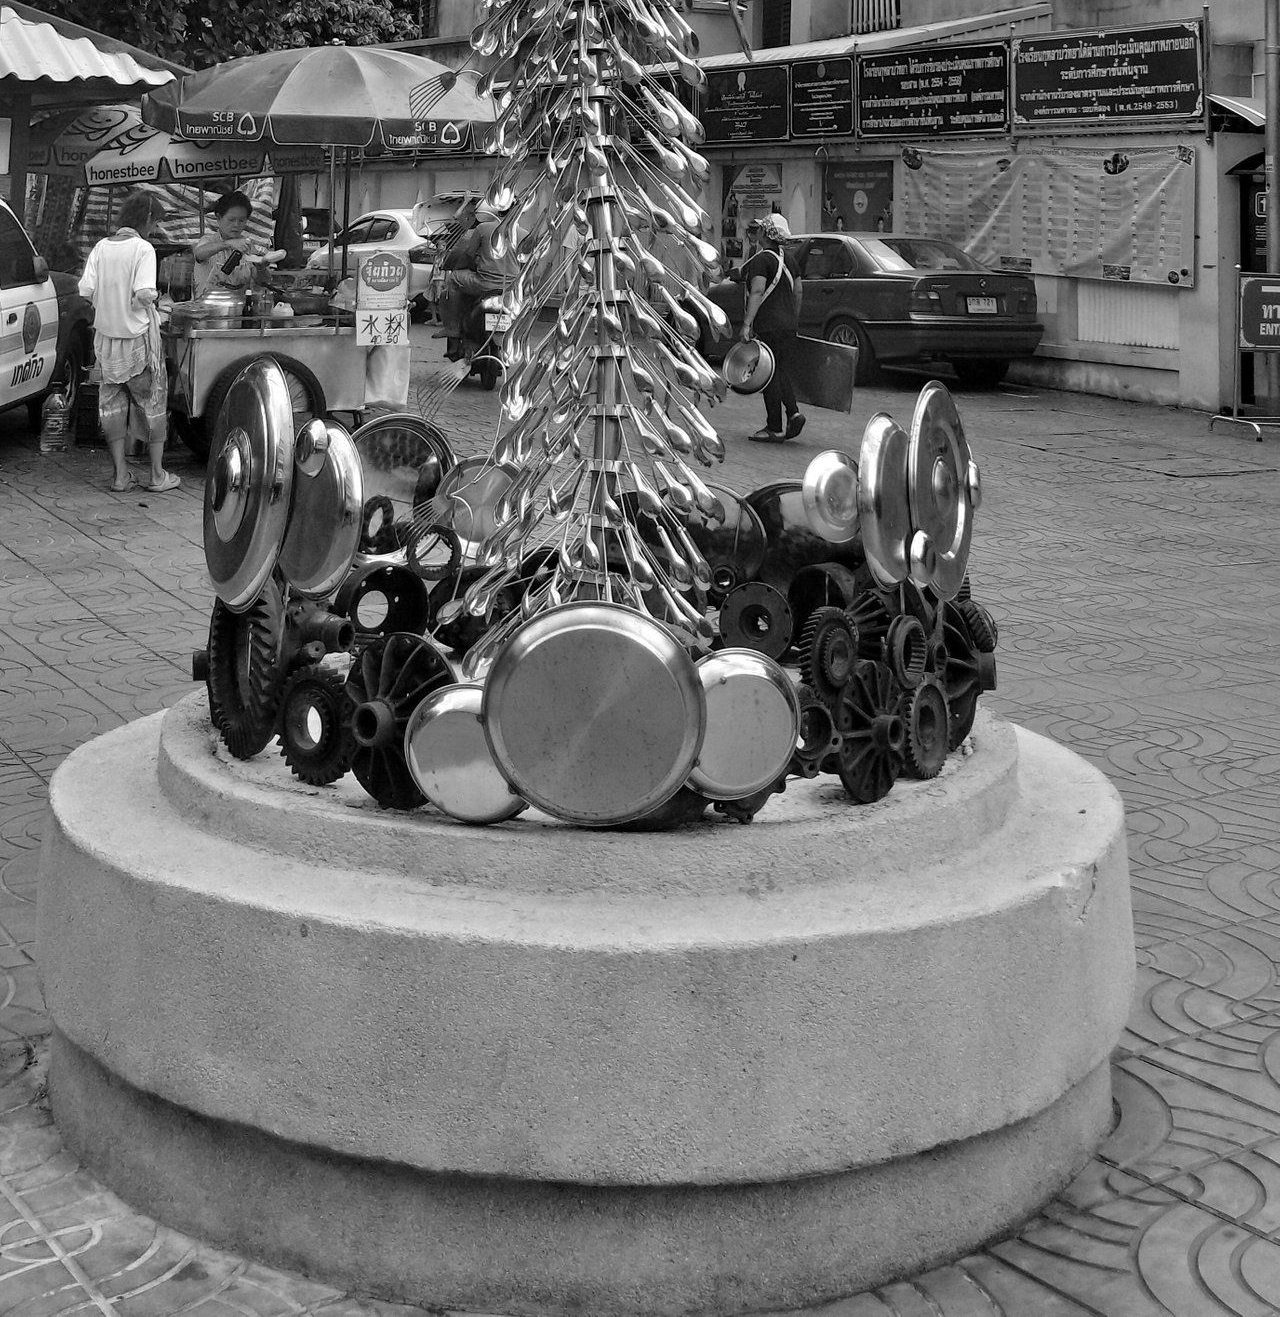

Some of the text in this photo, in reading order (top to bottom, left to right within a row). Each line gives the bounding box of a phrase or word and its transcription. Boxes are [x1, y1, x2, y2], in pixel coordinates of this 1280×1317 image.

[212, 111, 234, 122] SCB
[186, 124, 234, 135] ไทยพาณิชย์
[90, 163, 155, 181] honestbee
[175, 156, 258, 174] honestbee
[385, 335, 399, 344] 50
[10, 353, 44, 387] เทศกิจ
